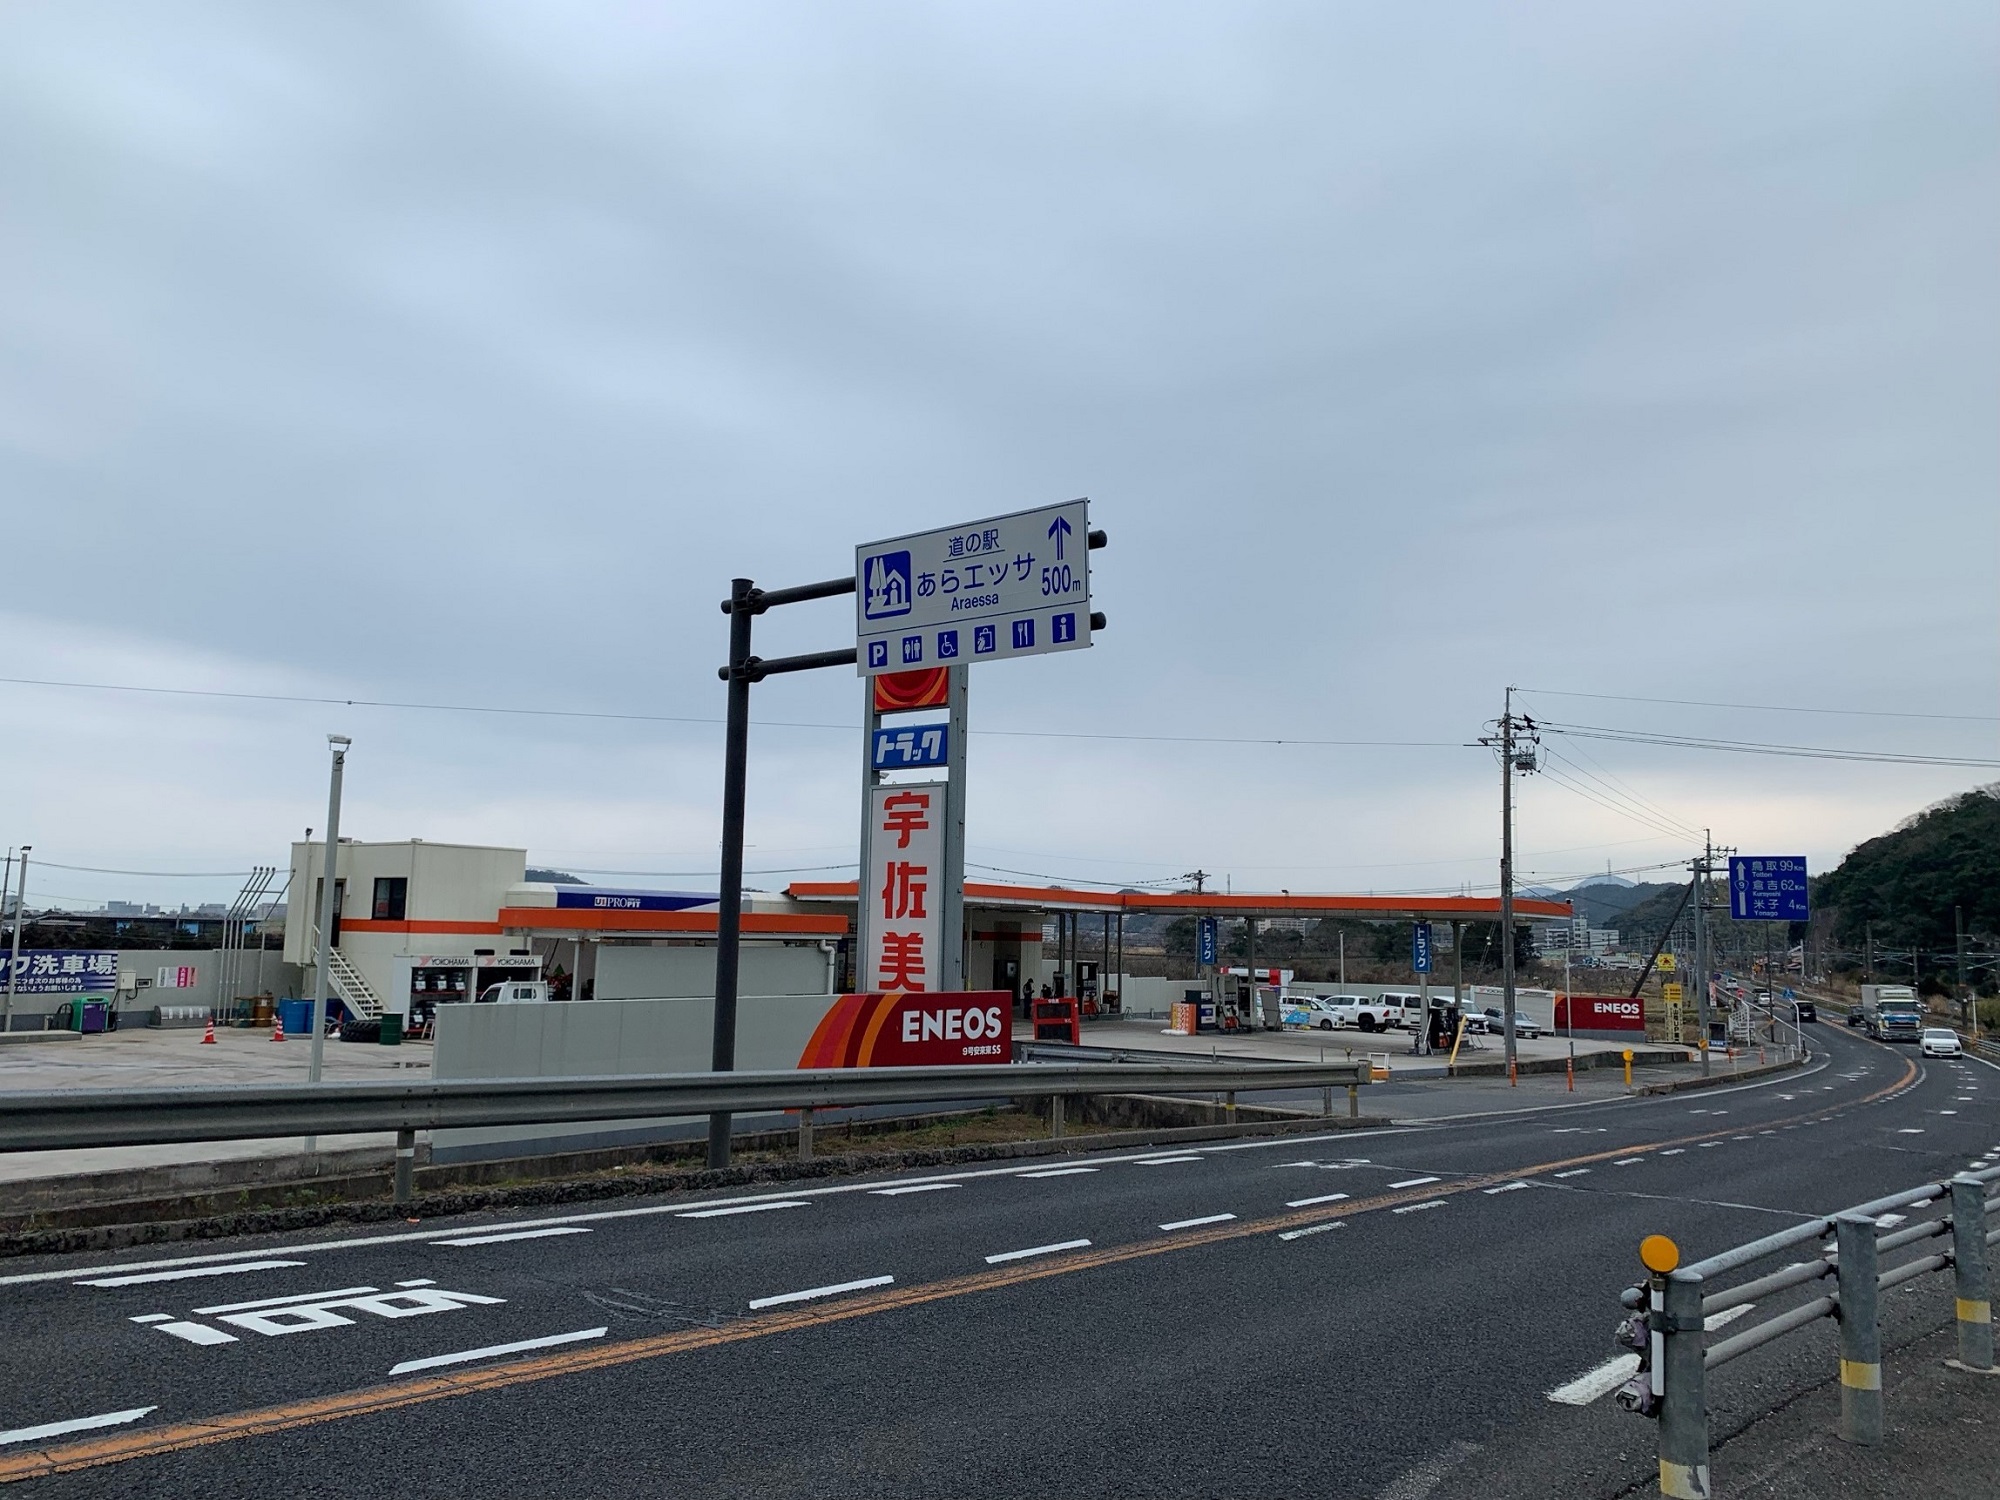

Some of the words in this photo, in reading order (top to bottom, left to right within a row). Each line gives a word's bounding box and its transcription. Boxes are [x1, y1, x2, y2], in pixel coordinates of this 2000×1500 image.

[948, 528, 999, 557] 道の駅
[951, 593, 999, 612] Araessa
[876, 730, 942, 763] トラック
[1752, 861, 1778, 871] 鳥取
[879, 791, 930, 993] 宇佐美
[1739, 881, 1745, 889] 9
[1752, 880, 1778, 890] 倉吉
[1753, 899, 1779, 909] 米子
[1203, 922, 1212, 960] トラック
[1417, 926, 1426, 967] トラック
[431, 958, 469, 966] YOKOHAMA
[497, 958, 535, 966] YOKOHAMA
[1594, 1002, 1640, 1014] ENEOS
[902, 1006, 1002, 1043] ENEOS
